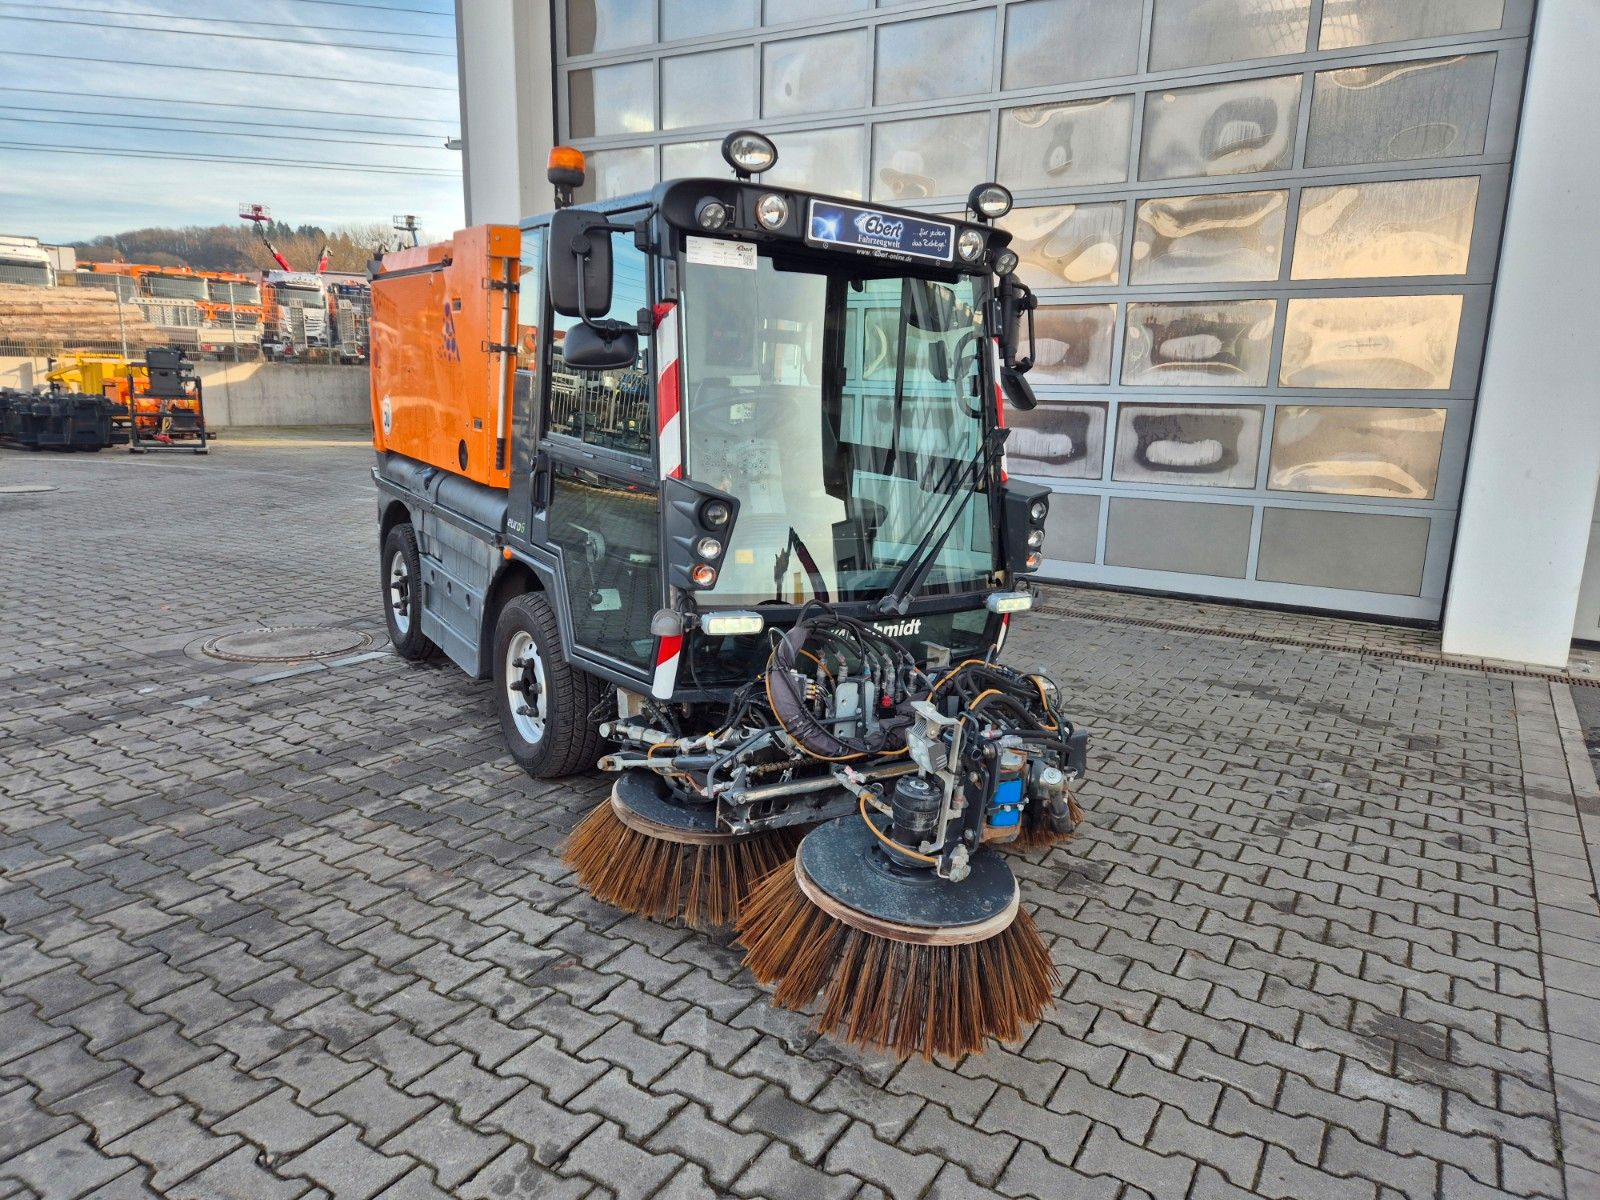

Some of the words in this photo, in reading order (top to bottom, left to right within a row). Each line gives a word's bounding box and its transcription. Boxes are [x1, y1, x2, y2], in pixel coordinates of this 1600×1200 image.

[865, 216, 902, 238] Ebert
[930, 228, 946, 238] jeden
[858, 234, 901, 249] Fahrzeugwelt
[911, 238, 922, 248] das
[864, 619, 922, 639] hmidt
